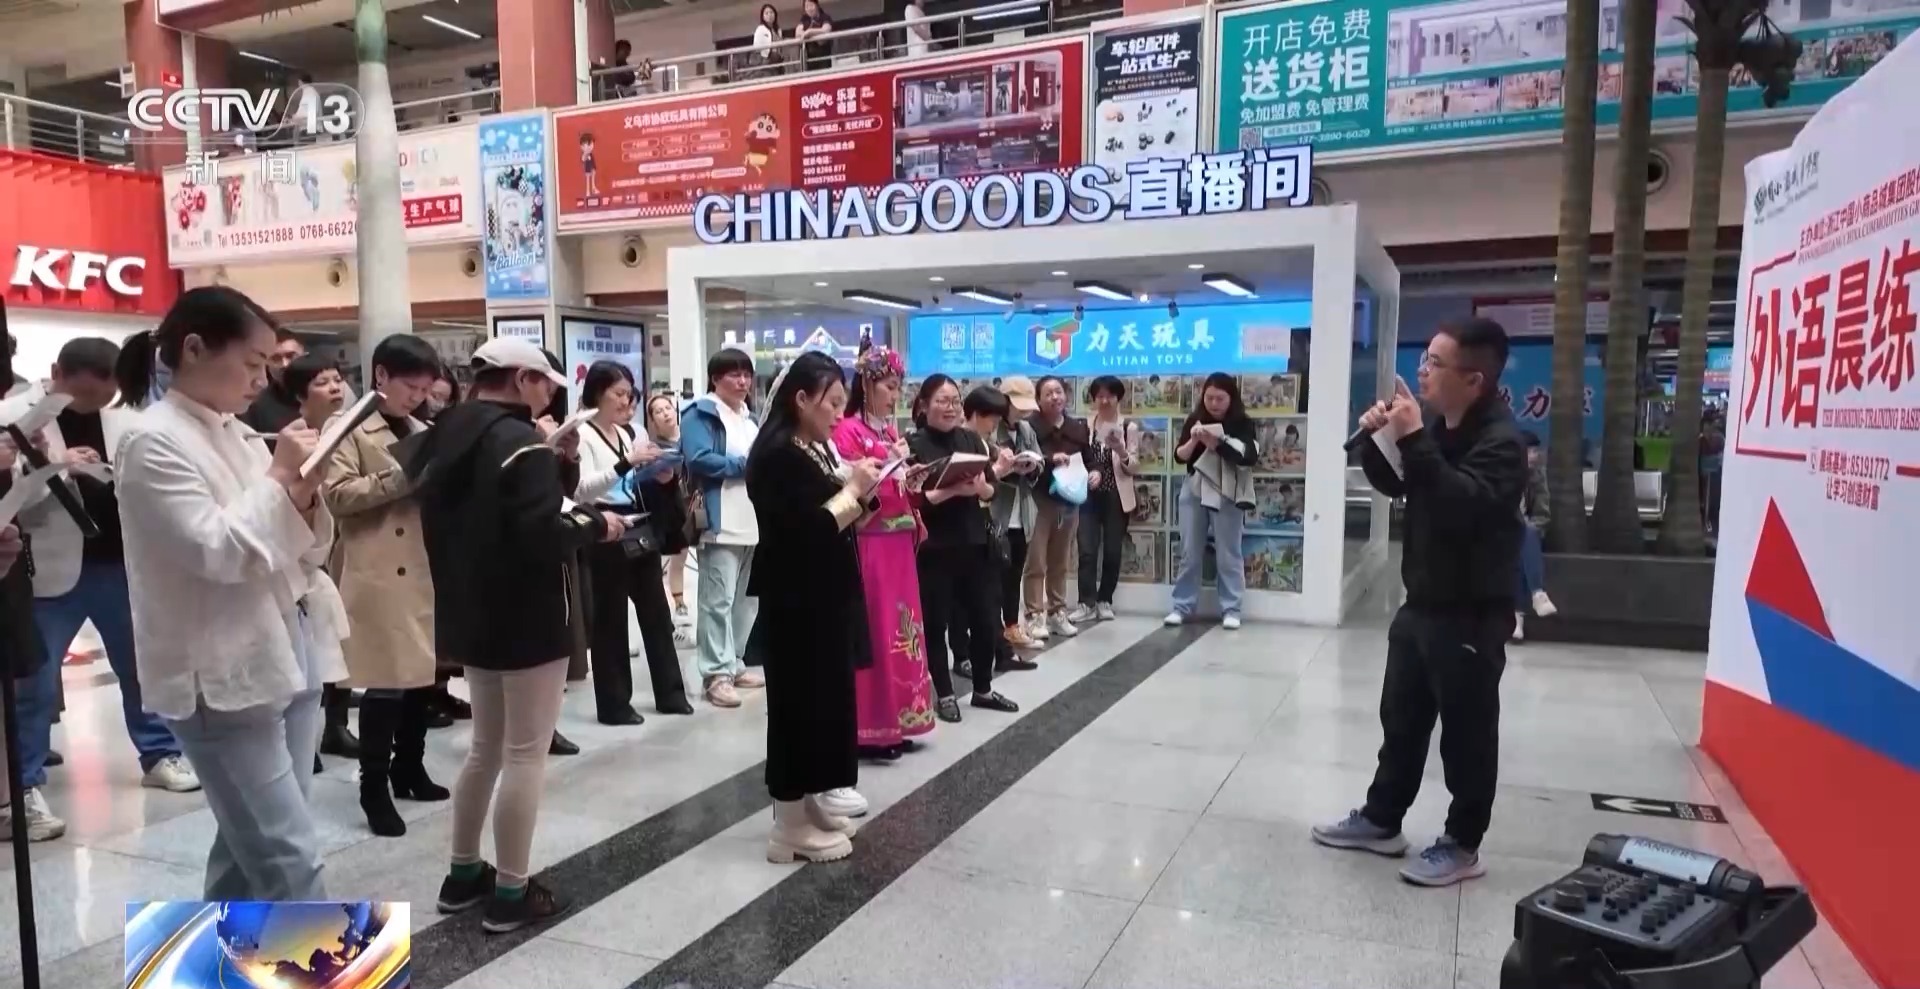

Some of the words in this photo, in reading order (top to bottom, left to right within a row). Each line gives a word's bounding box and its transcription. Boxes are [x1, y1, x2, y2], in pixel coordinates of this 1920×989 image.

[1110, 32, 1180, 57] 车轮配件
[1243, 8, 1371, 57] 开店免费
[1104, 50, 1192, 75] 一站式生产
[1240, 45, 1371, 103] 送货柜
[1240, 101, 1301, 125] 免加盟费
[1306, 93, 1369, 116] 免管理费
[694, 164, 1117, 244] CHINAGOODS
[1124, 144, 1313, 219] 直播间
[230, 226, 294, 245] 13531521888
[9, 245, 146, 296] KFC
[495, 251, 537, 272] Balloon
[1086, 318, 1215, 352] 力天玩具
[1744, 238, 1920, 429] 外语晨练
[1102, 355, 1149, 366] LITIAN
[1156, 353, 1194, 365] TOYS
